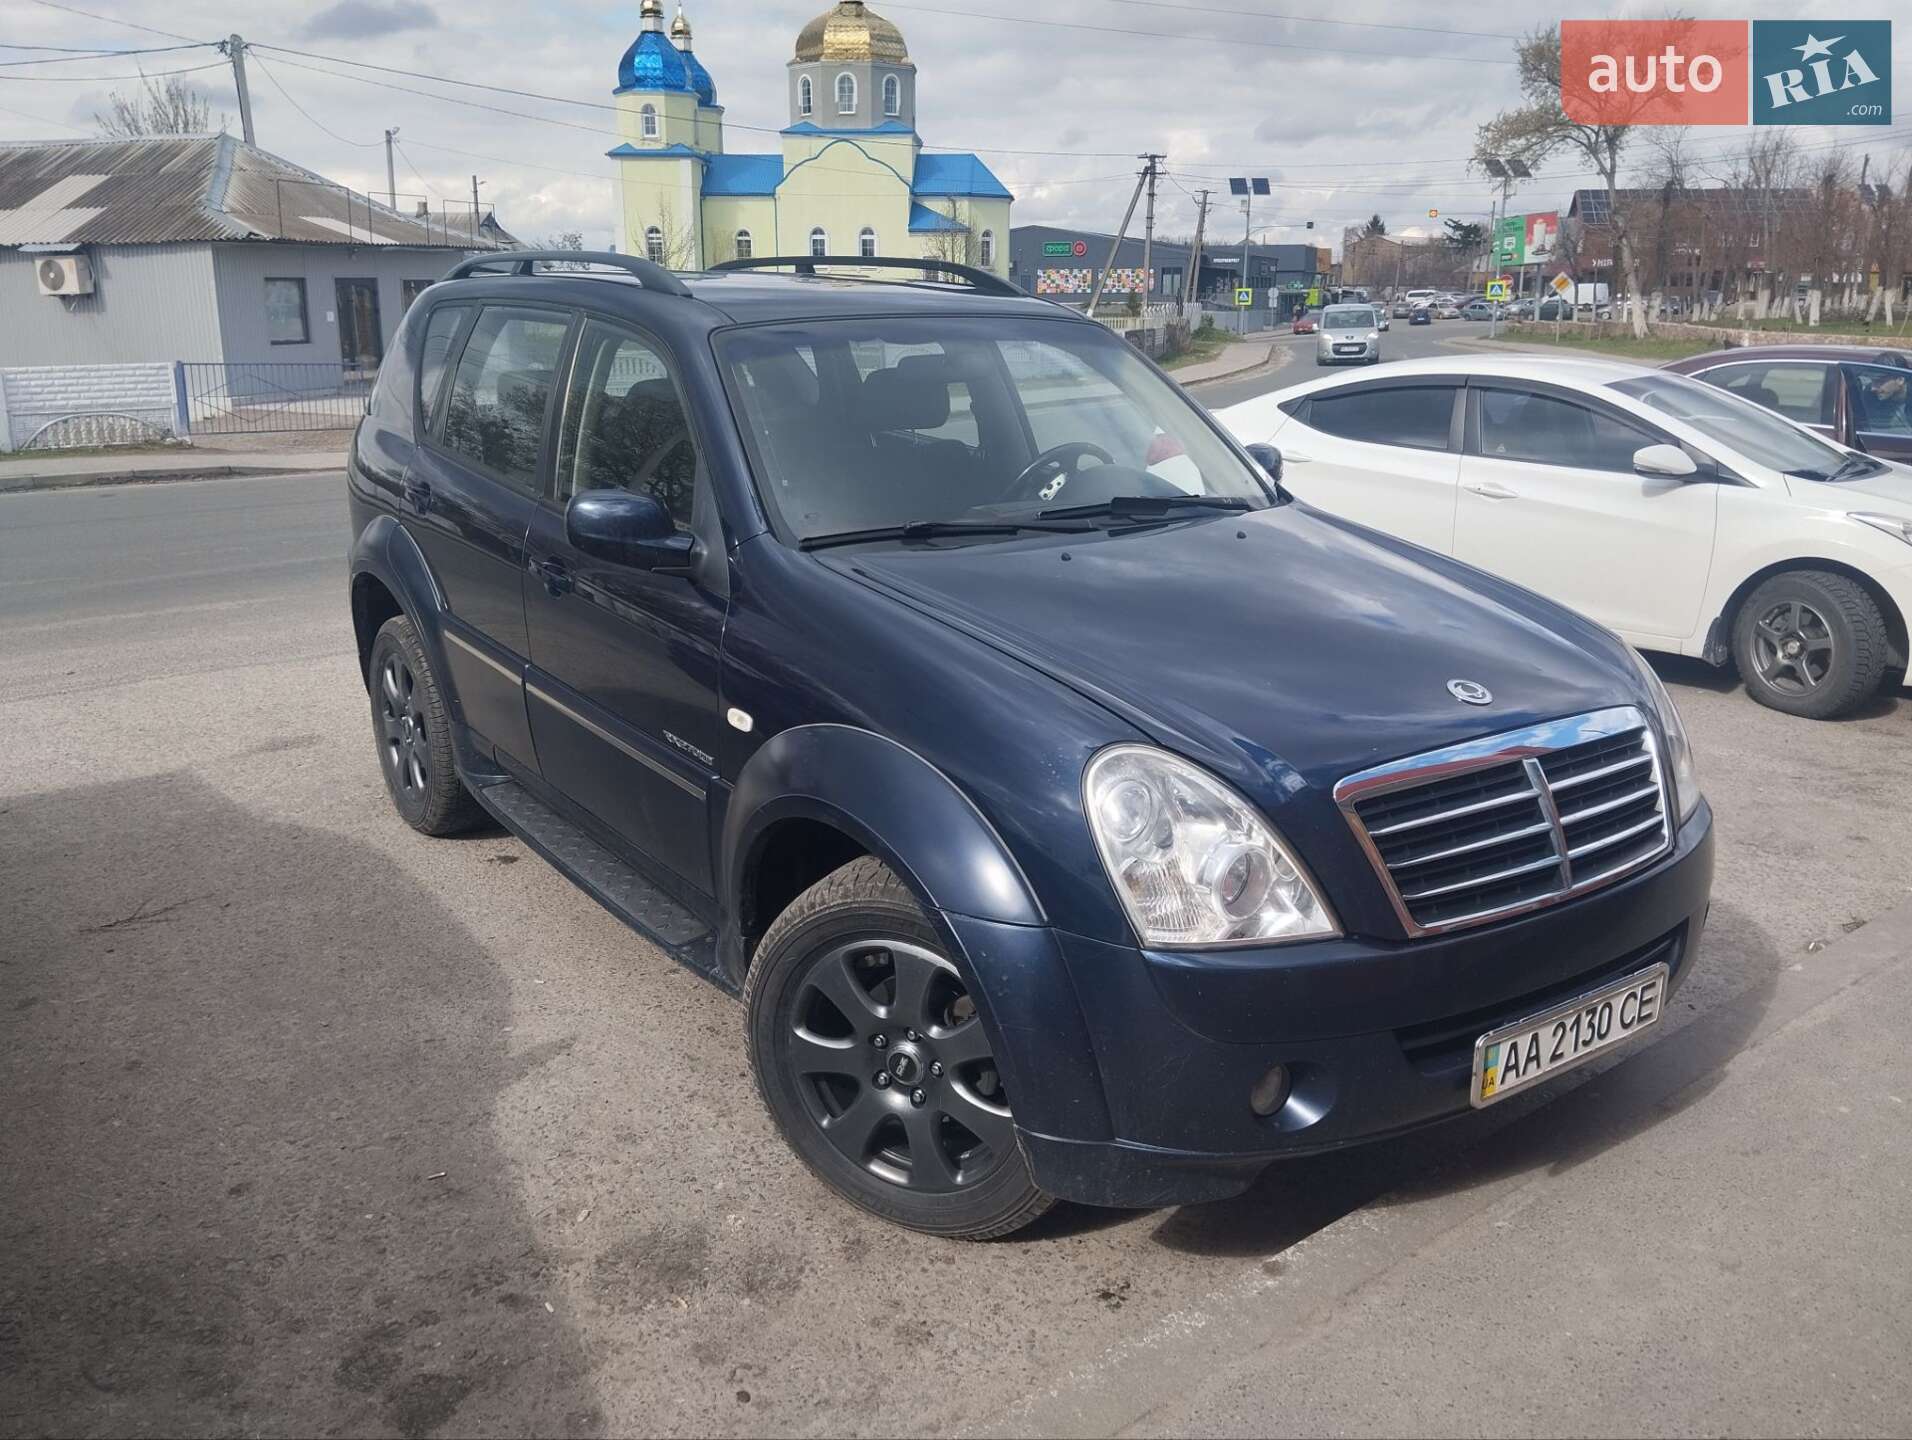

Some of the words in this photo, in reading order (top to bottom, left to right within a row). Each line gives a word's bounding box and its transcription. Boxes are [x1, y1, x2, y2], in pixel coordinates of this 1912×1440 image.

[1500, 1032, 1541, 1086] AA
[1549, 1001, 1613, 1063] 2130
[1619, 981, 1657, 1030] CE
